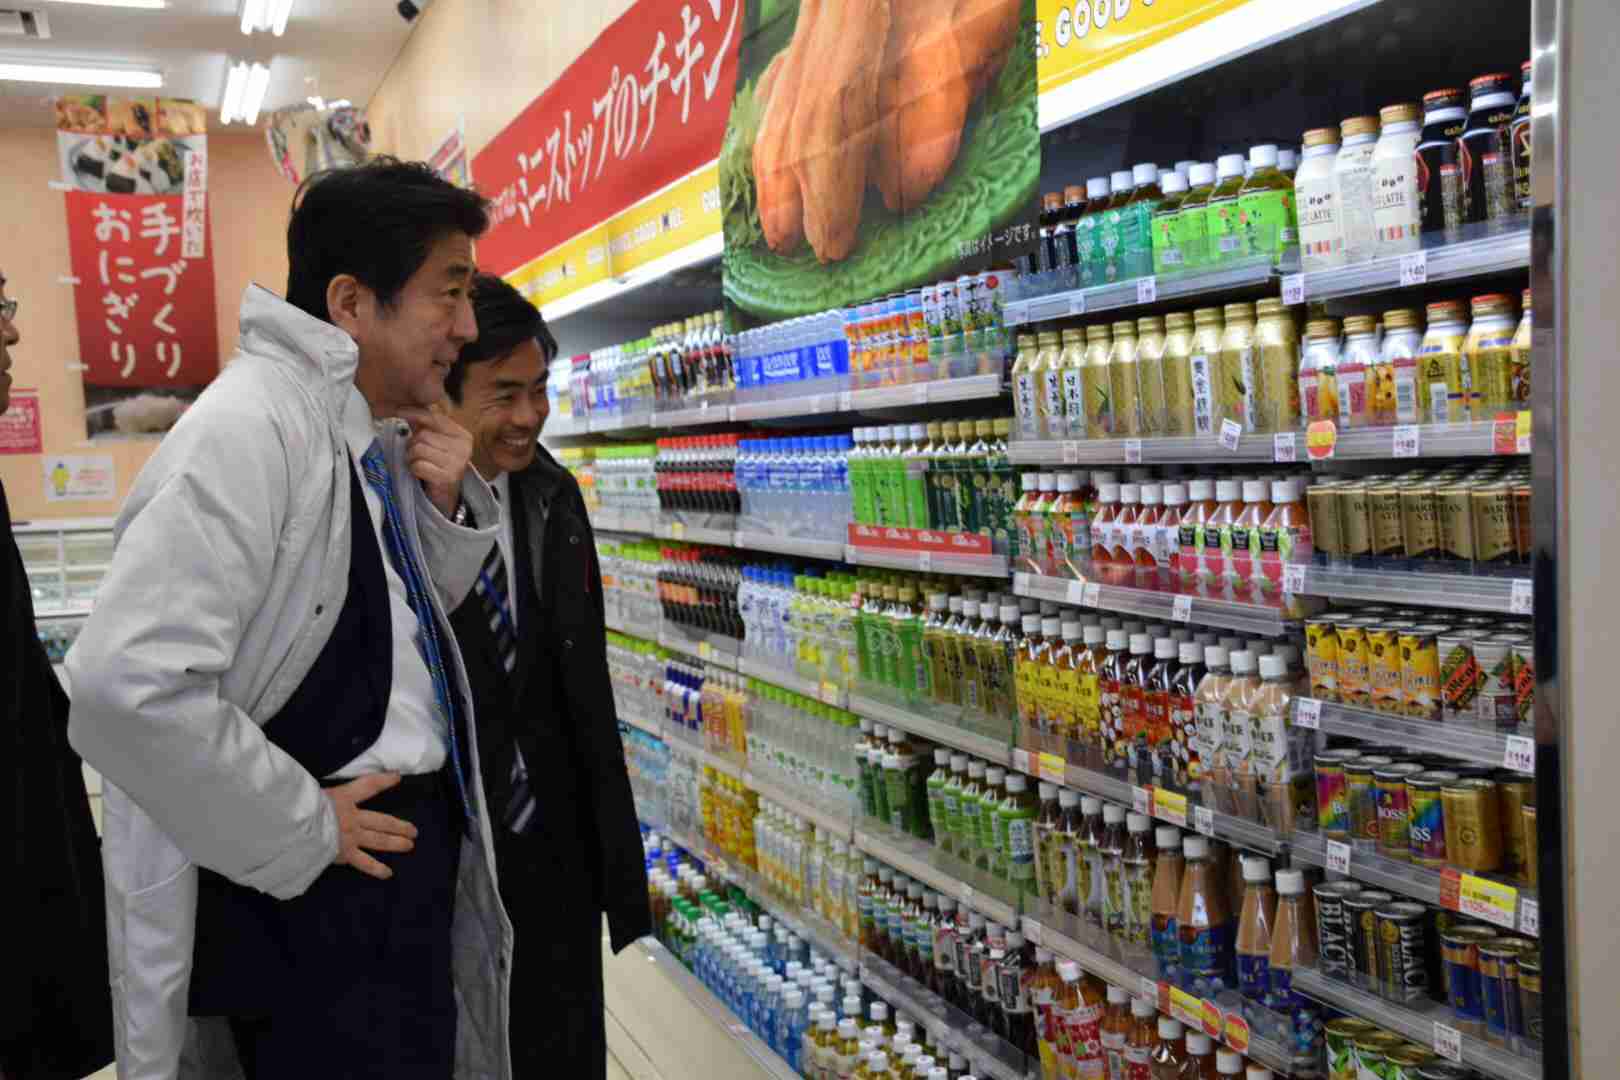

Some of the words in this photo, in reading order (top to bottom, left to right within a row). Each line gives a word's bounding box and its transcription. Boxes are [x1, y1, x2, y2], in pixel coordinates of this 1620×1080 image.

[91, 202, 137, 380] おにぎり
[140, 201, 187, 379] 手づくり
